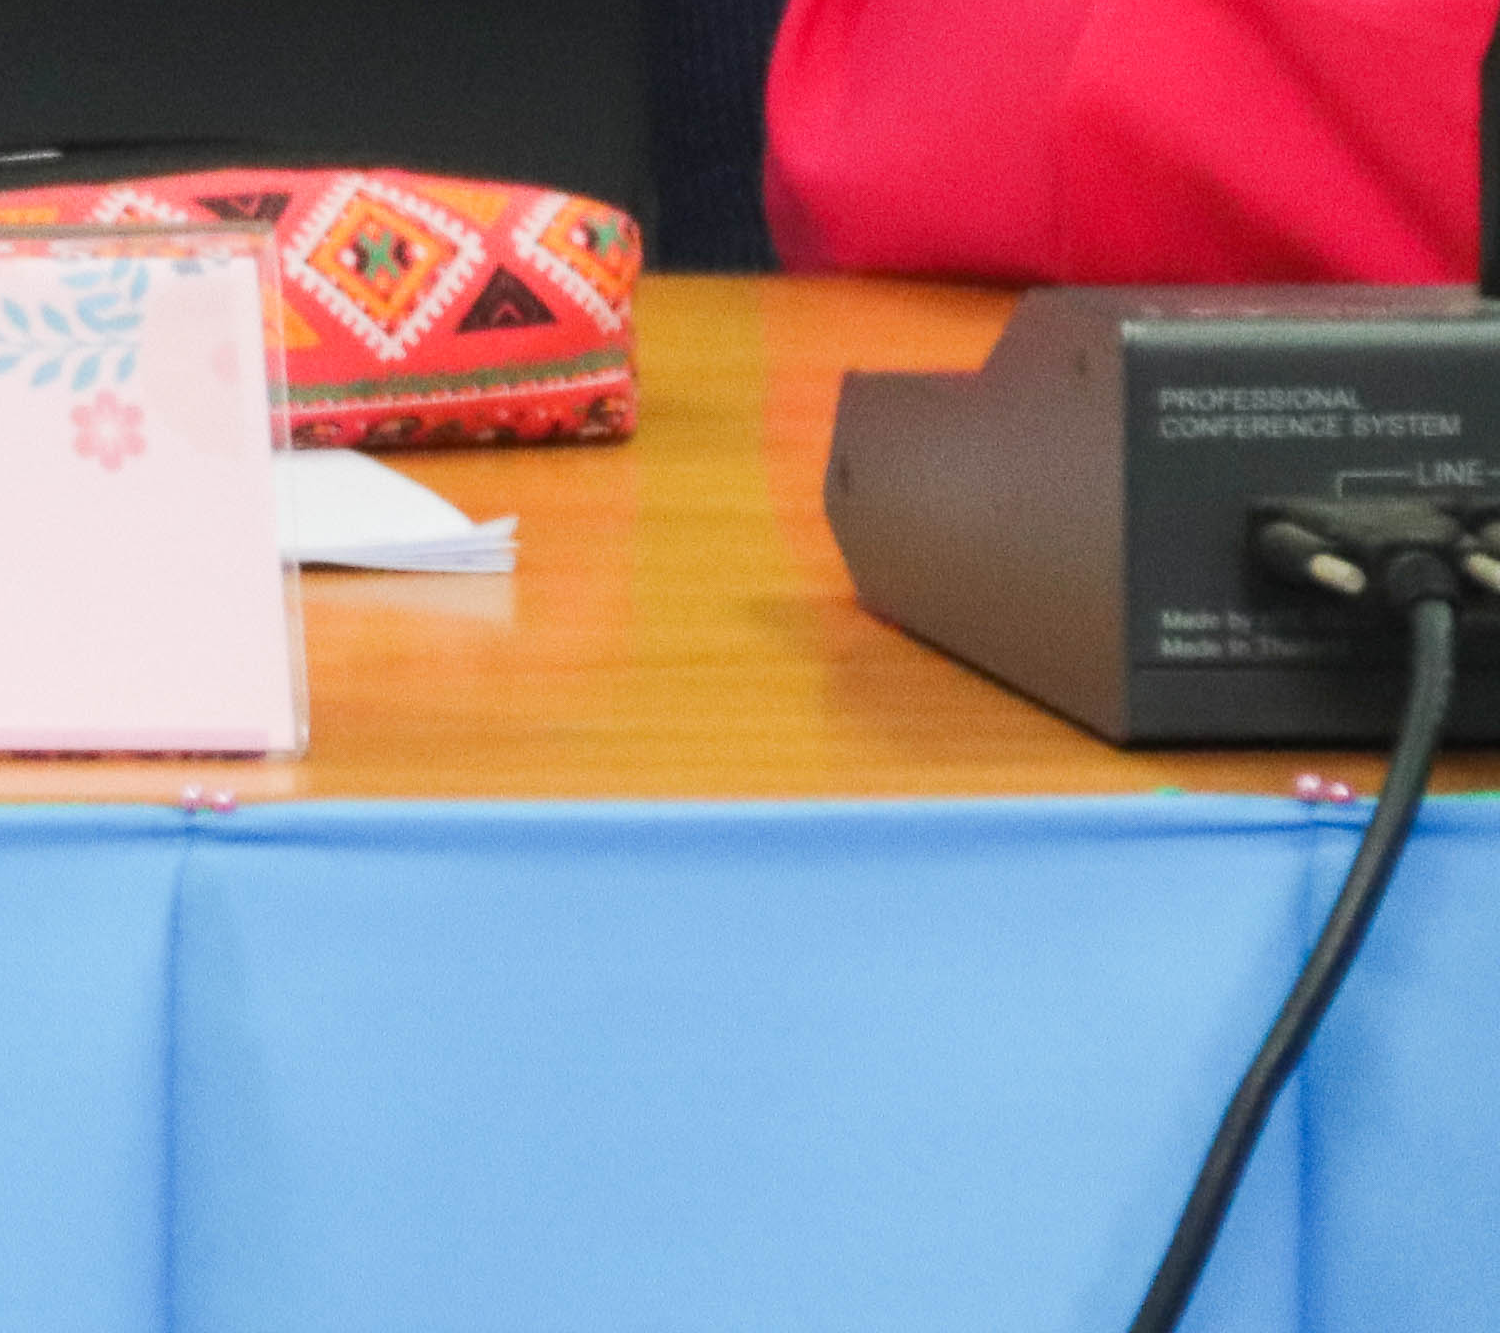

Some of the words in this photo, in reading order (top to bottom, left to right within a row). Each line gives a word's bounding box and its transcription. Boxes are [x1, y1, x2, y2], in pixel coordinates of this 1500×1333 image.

[1158, 387, 1361, 411] PROFESSIONAL
[1159, 414, 1342, 438] CONFERENCE
[1351, 413, 1461, 436] SYSTEM
[1416, 459, 1484, 486] LINE
